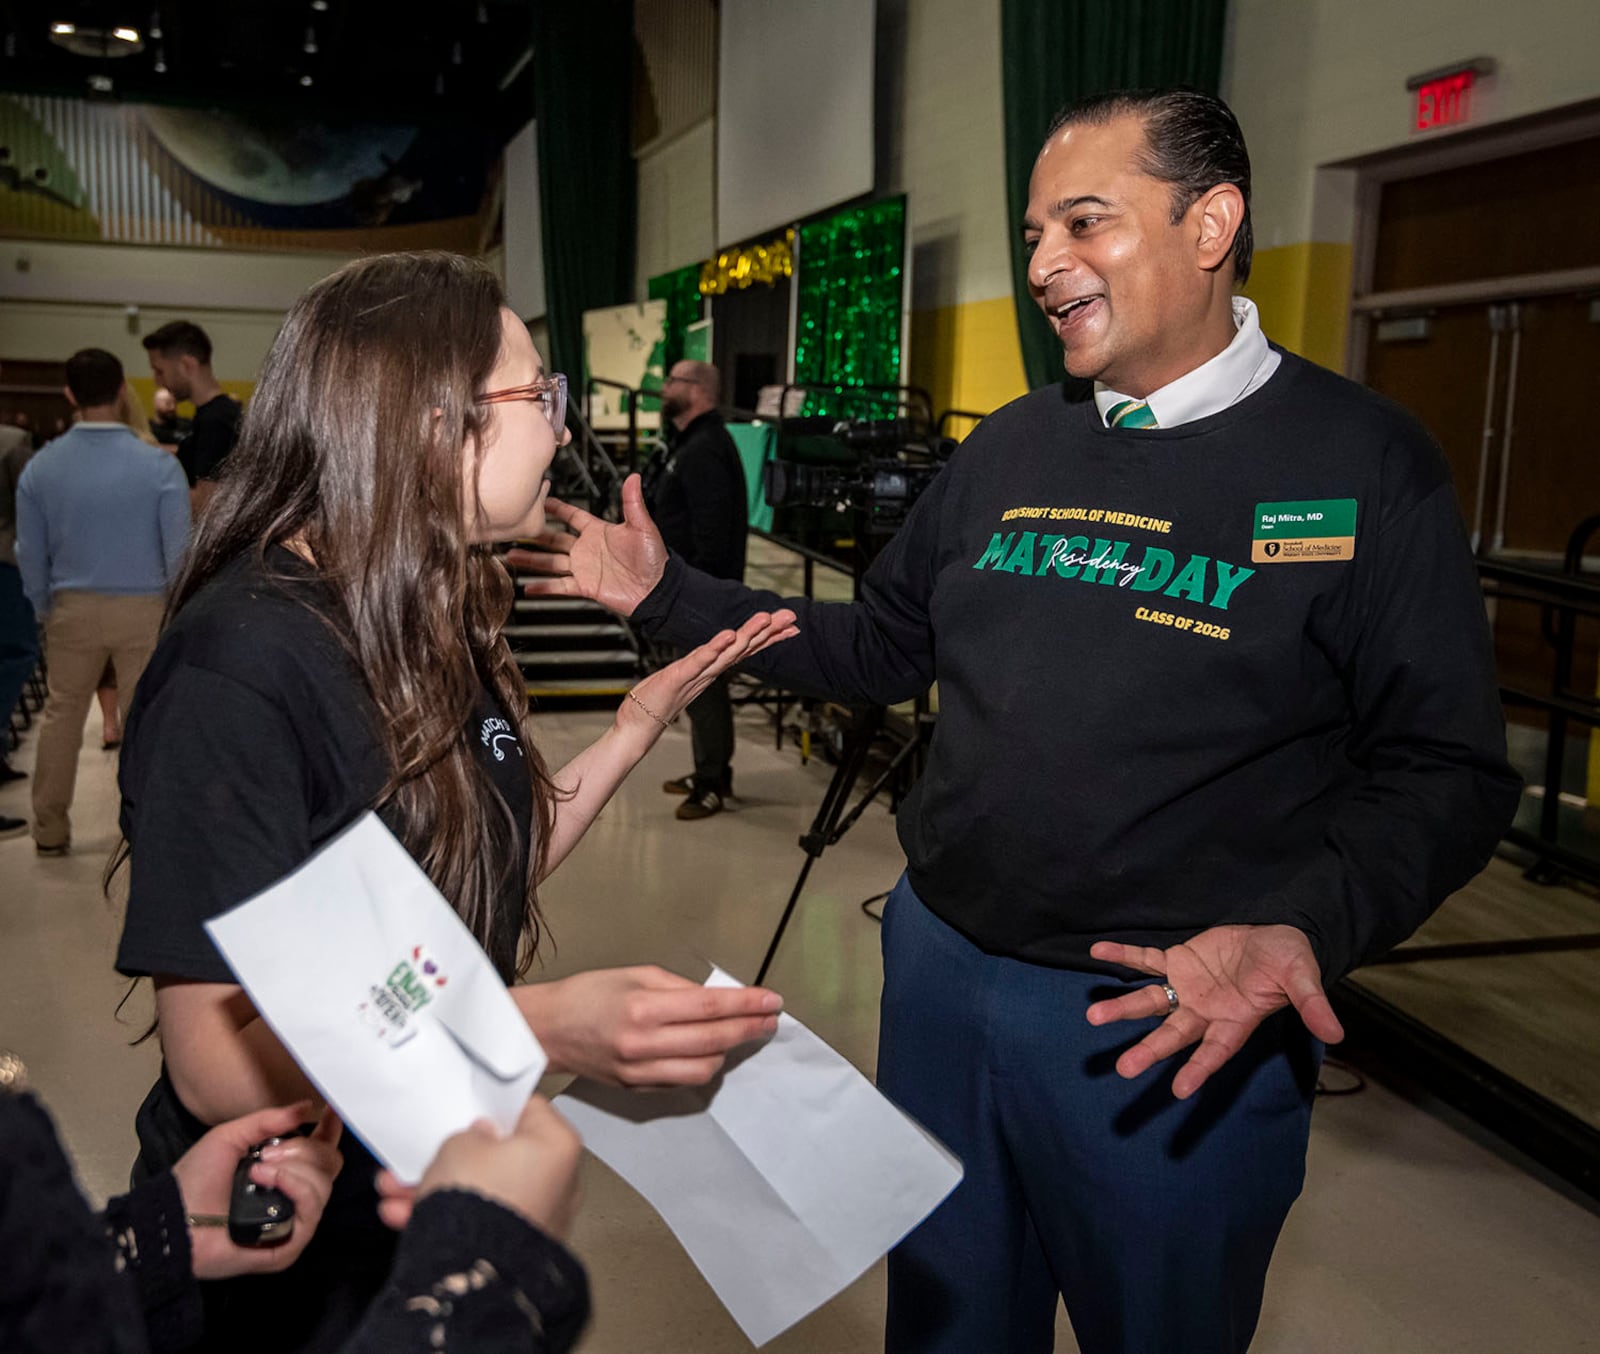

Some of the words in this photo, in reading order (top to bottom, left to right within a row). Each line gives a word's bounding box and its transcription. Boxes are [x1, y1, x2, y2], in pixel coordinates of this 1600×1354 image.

[1048, 508, 1088, 520] SCHOOL
[1088, 509, 1105, 522] OF
[1104, 511, 1173, 534] MEDICINE
[1262, 515, 1276, 523] Raj
[1278, 514, 1305, 522] Mitra,
[1307, 513, 1323, 521] MD
[972, 531, 1132, 586] MATCH
[1130, 546, 1256, 610] DAY
[1046, 538, 1146, 587] Residency
[1135, 607, 1175, 626] CLASS
[1174, 616, 1194, 631] OF
[1193, 621, 1231, 640] 2026
[481, 717, 505, 746] MATCH
